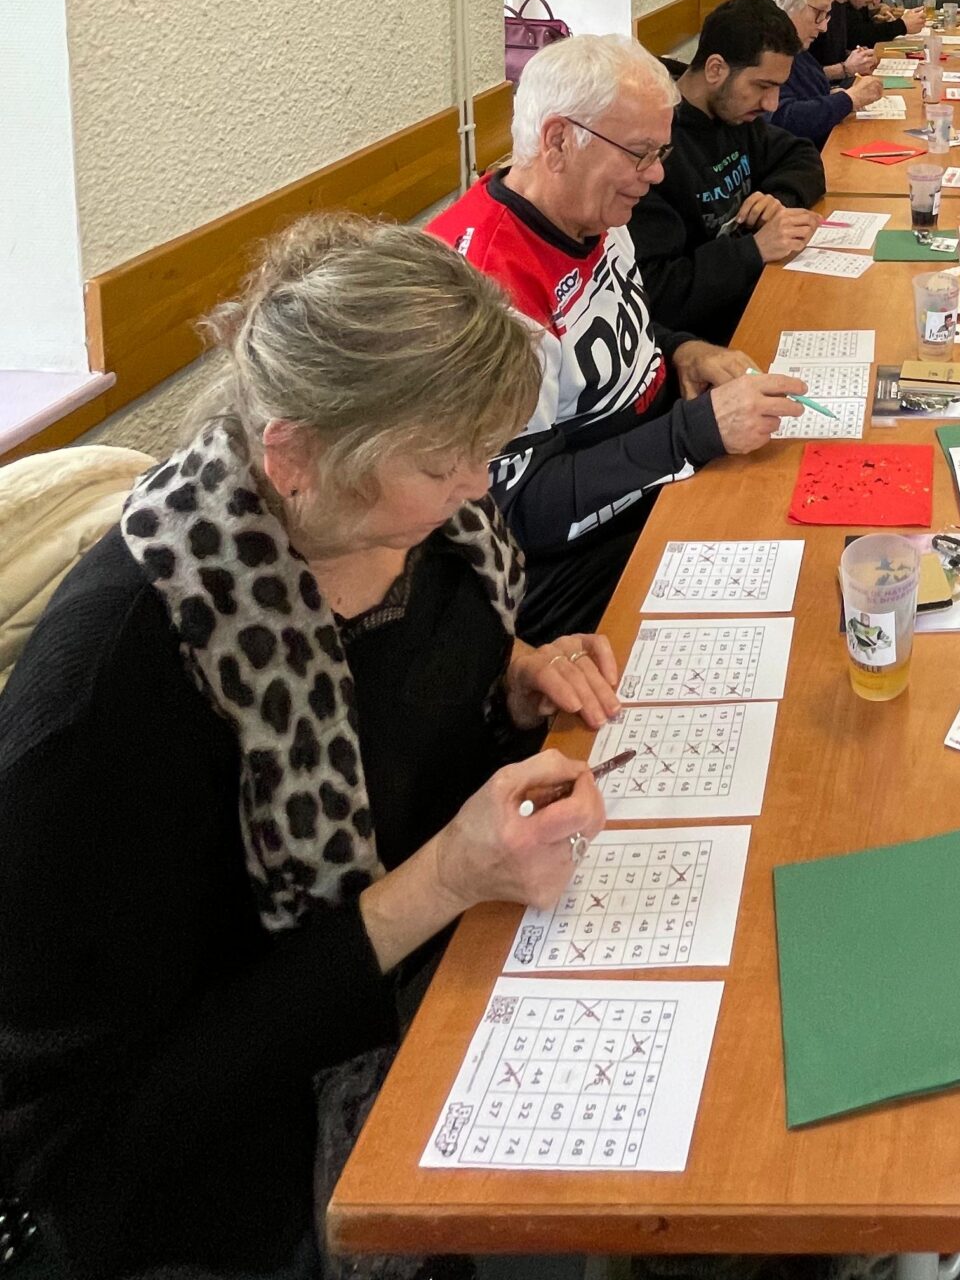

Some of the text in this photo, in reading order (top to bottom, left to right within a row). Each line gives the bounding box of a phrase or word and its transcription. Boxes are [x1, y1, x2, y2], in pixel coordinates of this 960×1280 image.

[629, 730, 637, 738] 28
[650, 730, 658, 738] 20
[716, 728, 724, 736] 29
[638, 764, 648, 773] 50
[611, 783, 620, 793] 74
[658, 782, 666, 791] 69
[625, 873, 635, 884] 27
[584, 851, 615, 933] 13 17 49
[565, 898, 577, 910] 32
[631, 850, 666, 957] 15 29 33 48 62
[671, 893, 680, 906] 43
[557, 923, 568, 934] 51
[611, 921, 621, 933] 60
[665, 919, 675, 931] 54
[549, 947, 558, 960] 68
[604, 945, 615, 959] 74
[658, 944, 670, 957] 73
[514, 1036, 528, 1051] 25
[506, 1008, 565, 1155] 15 22 44 52 74
[572, 1009, 624, 1156] 11 17 58 68
[604, 1010, 651, 1156] 10 33 54 69
[539, 1038, 585, 1155] 16 60 73
[489, 1101, 502, 1118] 57
[474, 1135, 489, 1153] 72
